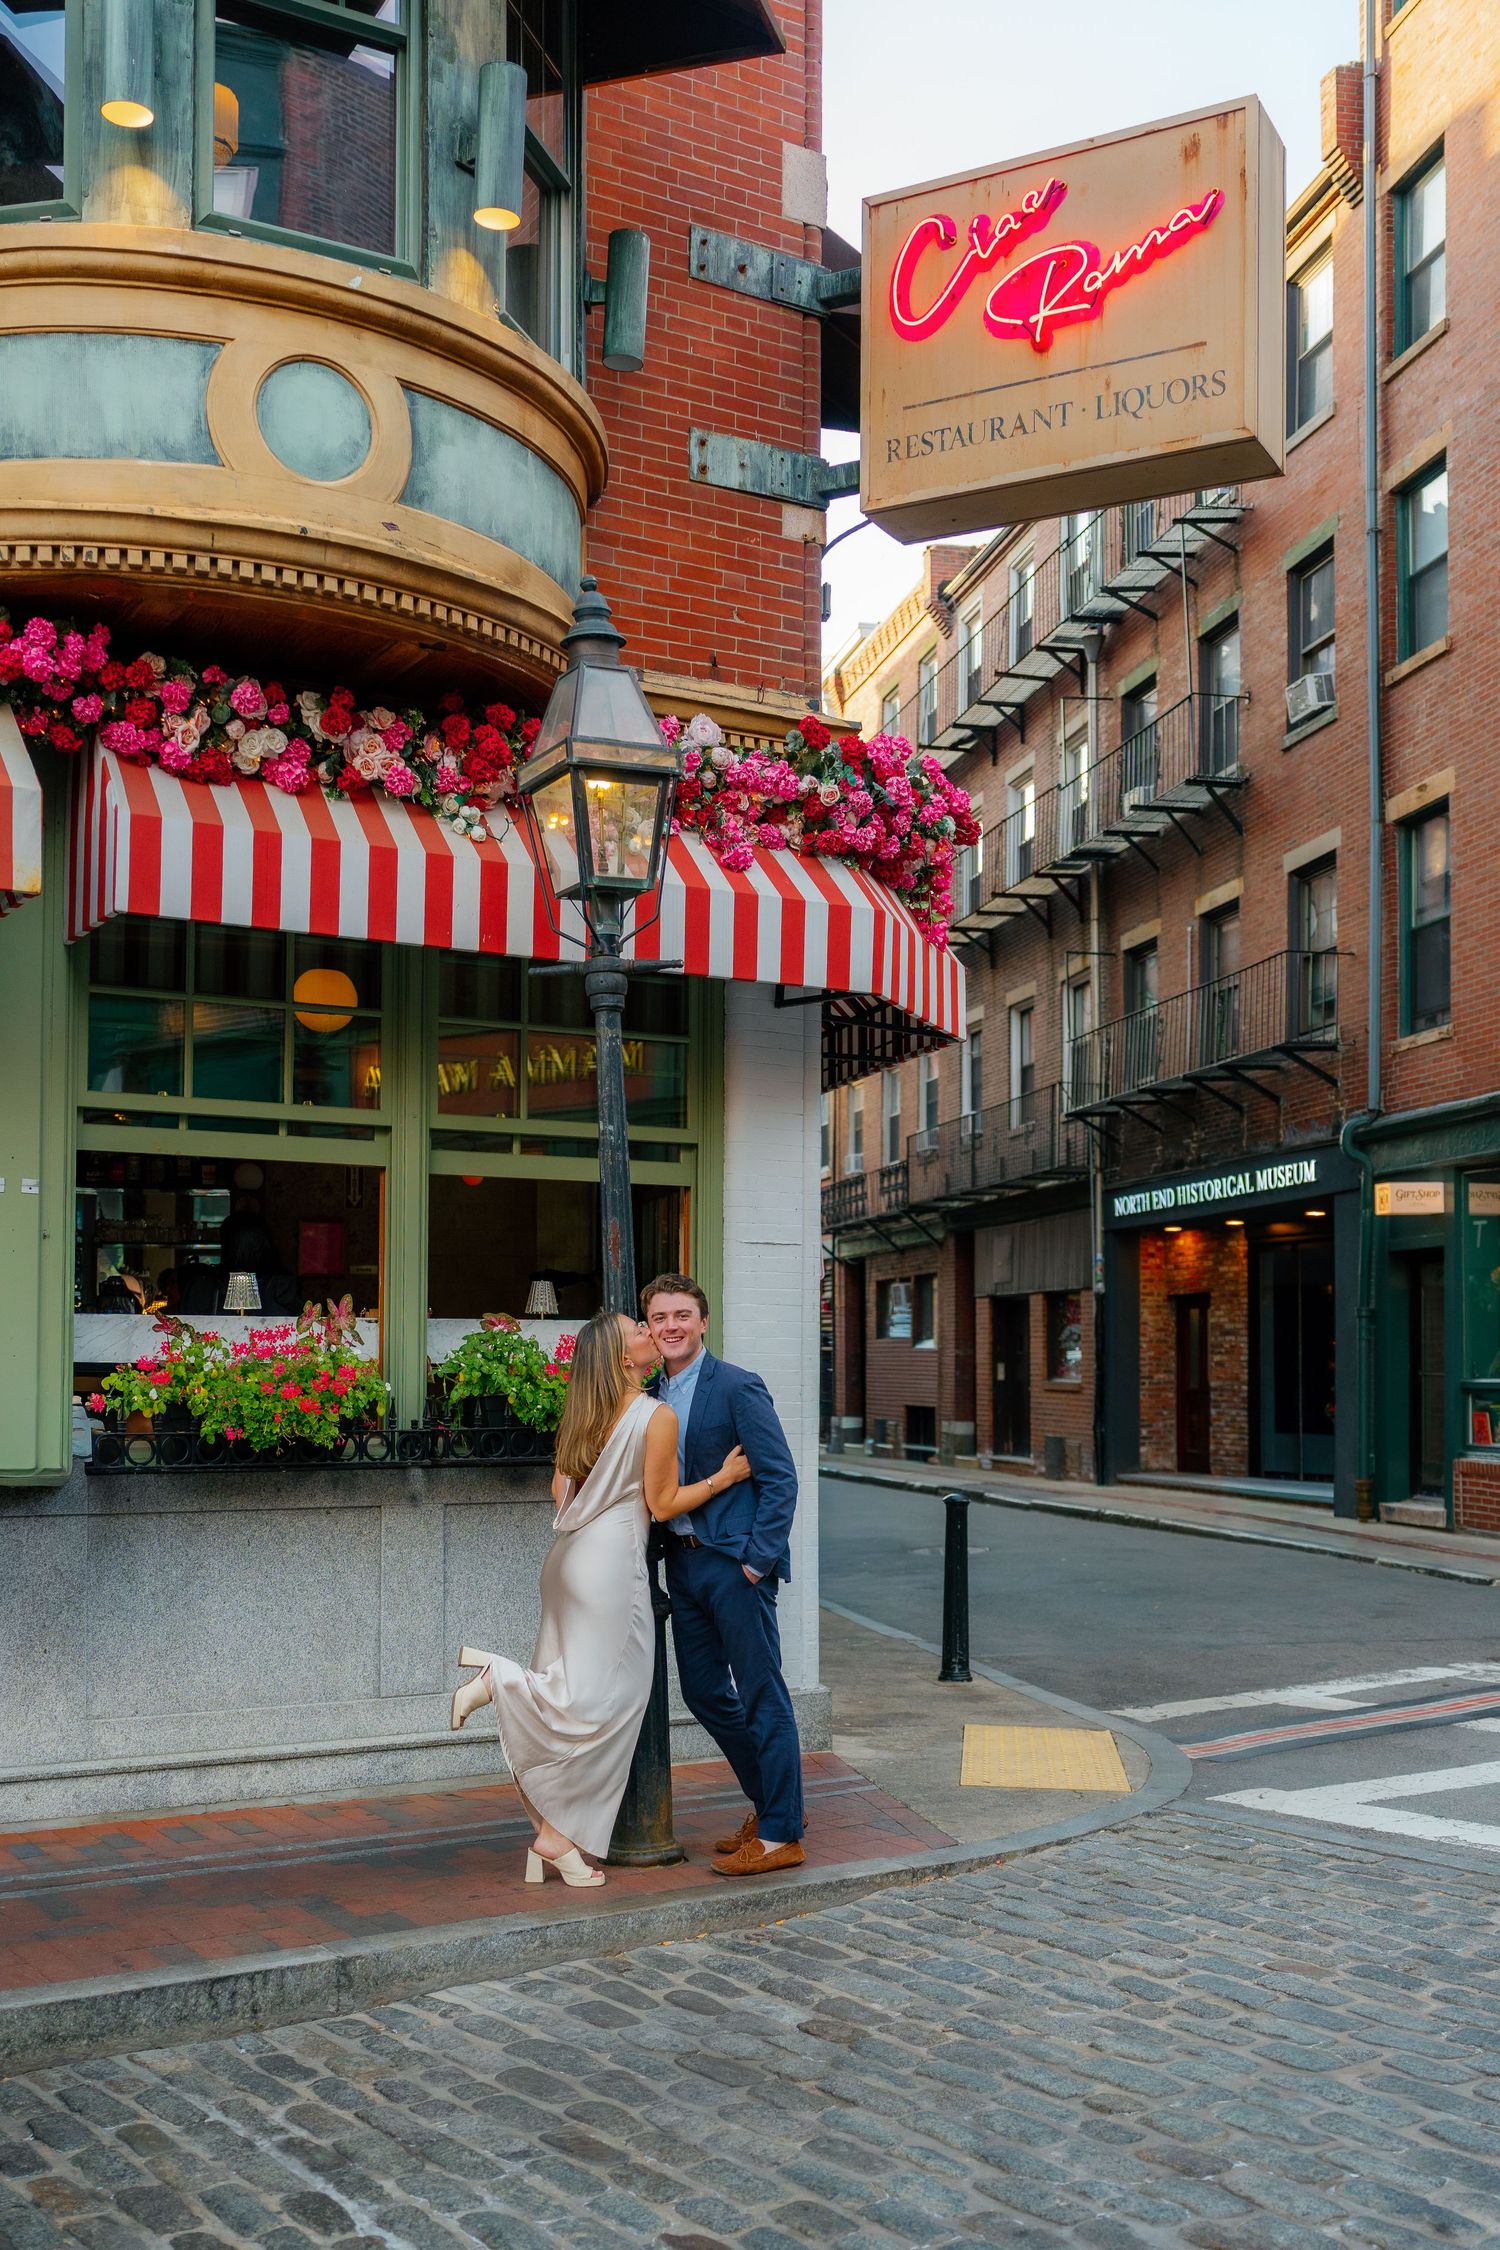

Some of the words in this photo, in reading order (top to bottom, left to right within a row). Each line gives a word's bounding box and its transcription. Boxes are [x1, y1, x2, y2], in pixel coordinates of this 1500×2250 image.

[891, 176, 1067, 330] Ciao
[984, 186, 1223, 345] Roma
[886, 401, 1074, 463] RESTAURANT
[1095, 369, 1226, 419] LIQUORS
[1114, 1191, 1150, 1217] NORTH
[1151, 1186, 1175, 1211] END
[1176, 1171, 1255, 1207] HISTORICAL
[1256, 1159, 1317, 1192] MUSEUM
